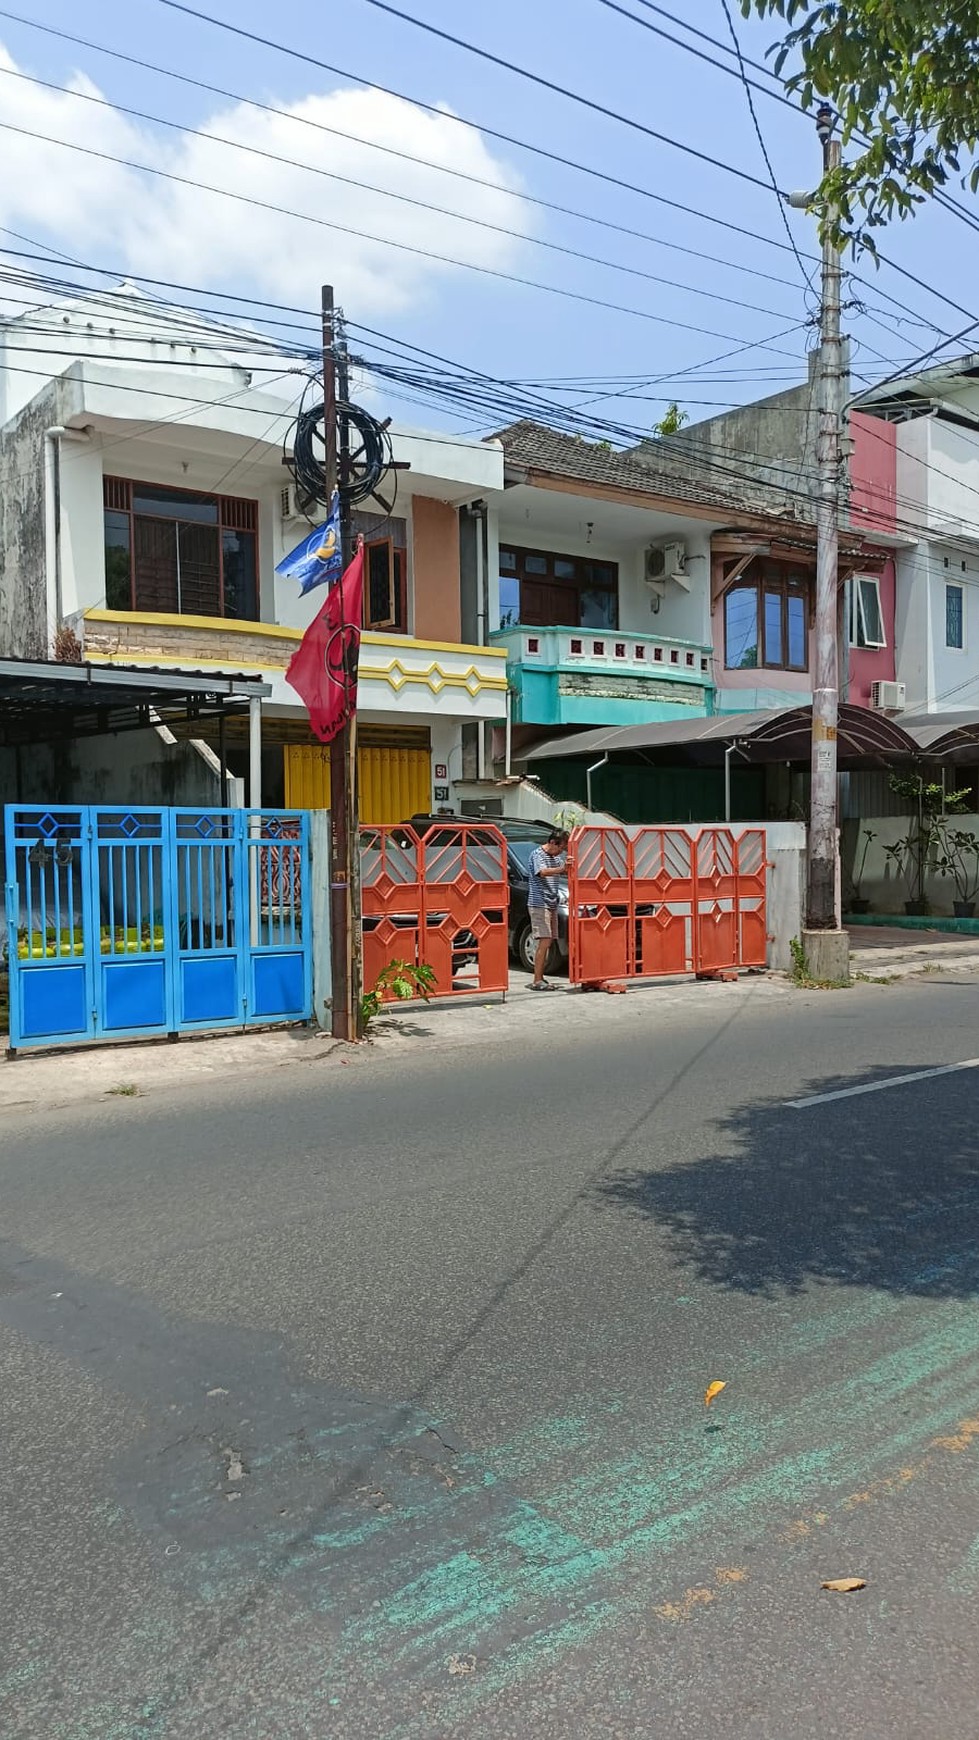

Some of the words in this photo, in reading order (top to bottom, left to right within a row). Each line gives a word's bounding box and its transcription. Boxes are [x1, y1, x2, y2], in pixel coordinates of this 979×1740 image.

[436, 766, 446, 777] 51
[436, 788, 447, 799] 51
[28, 837, 73, 867] 45
